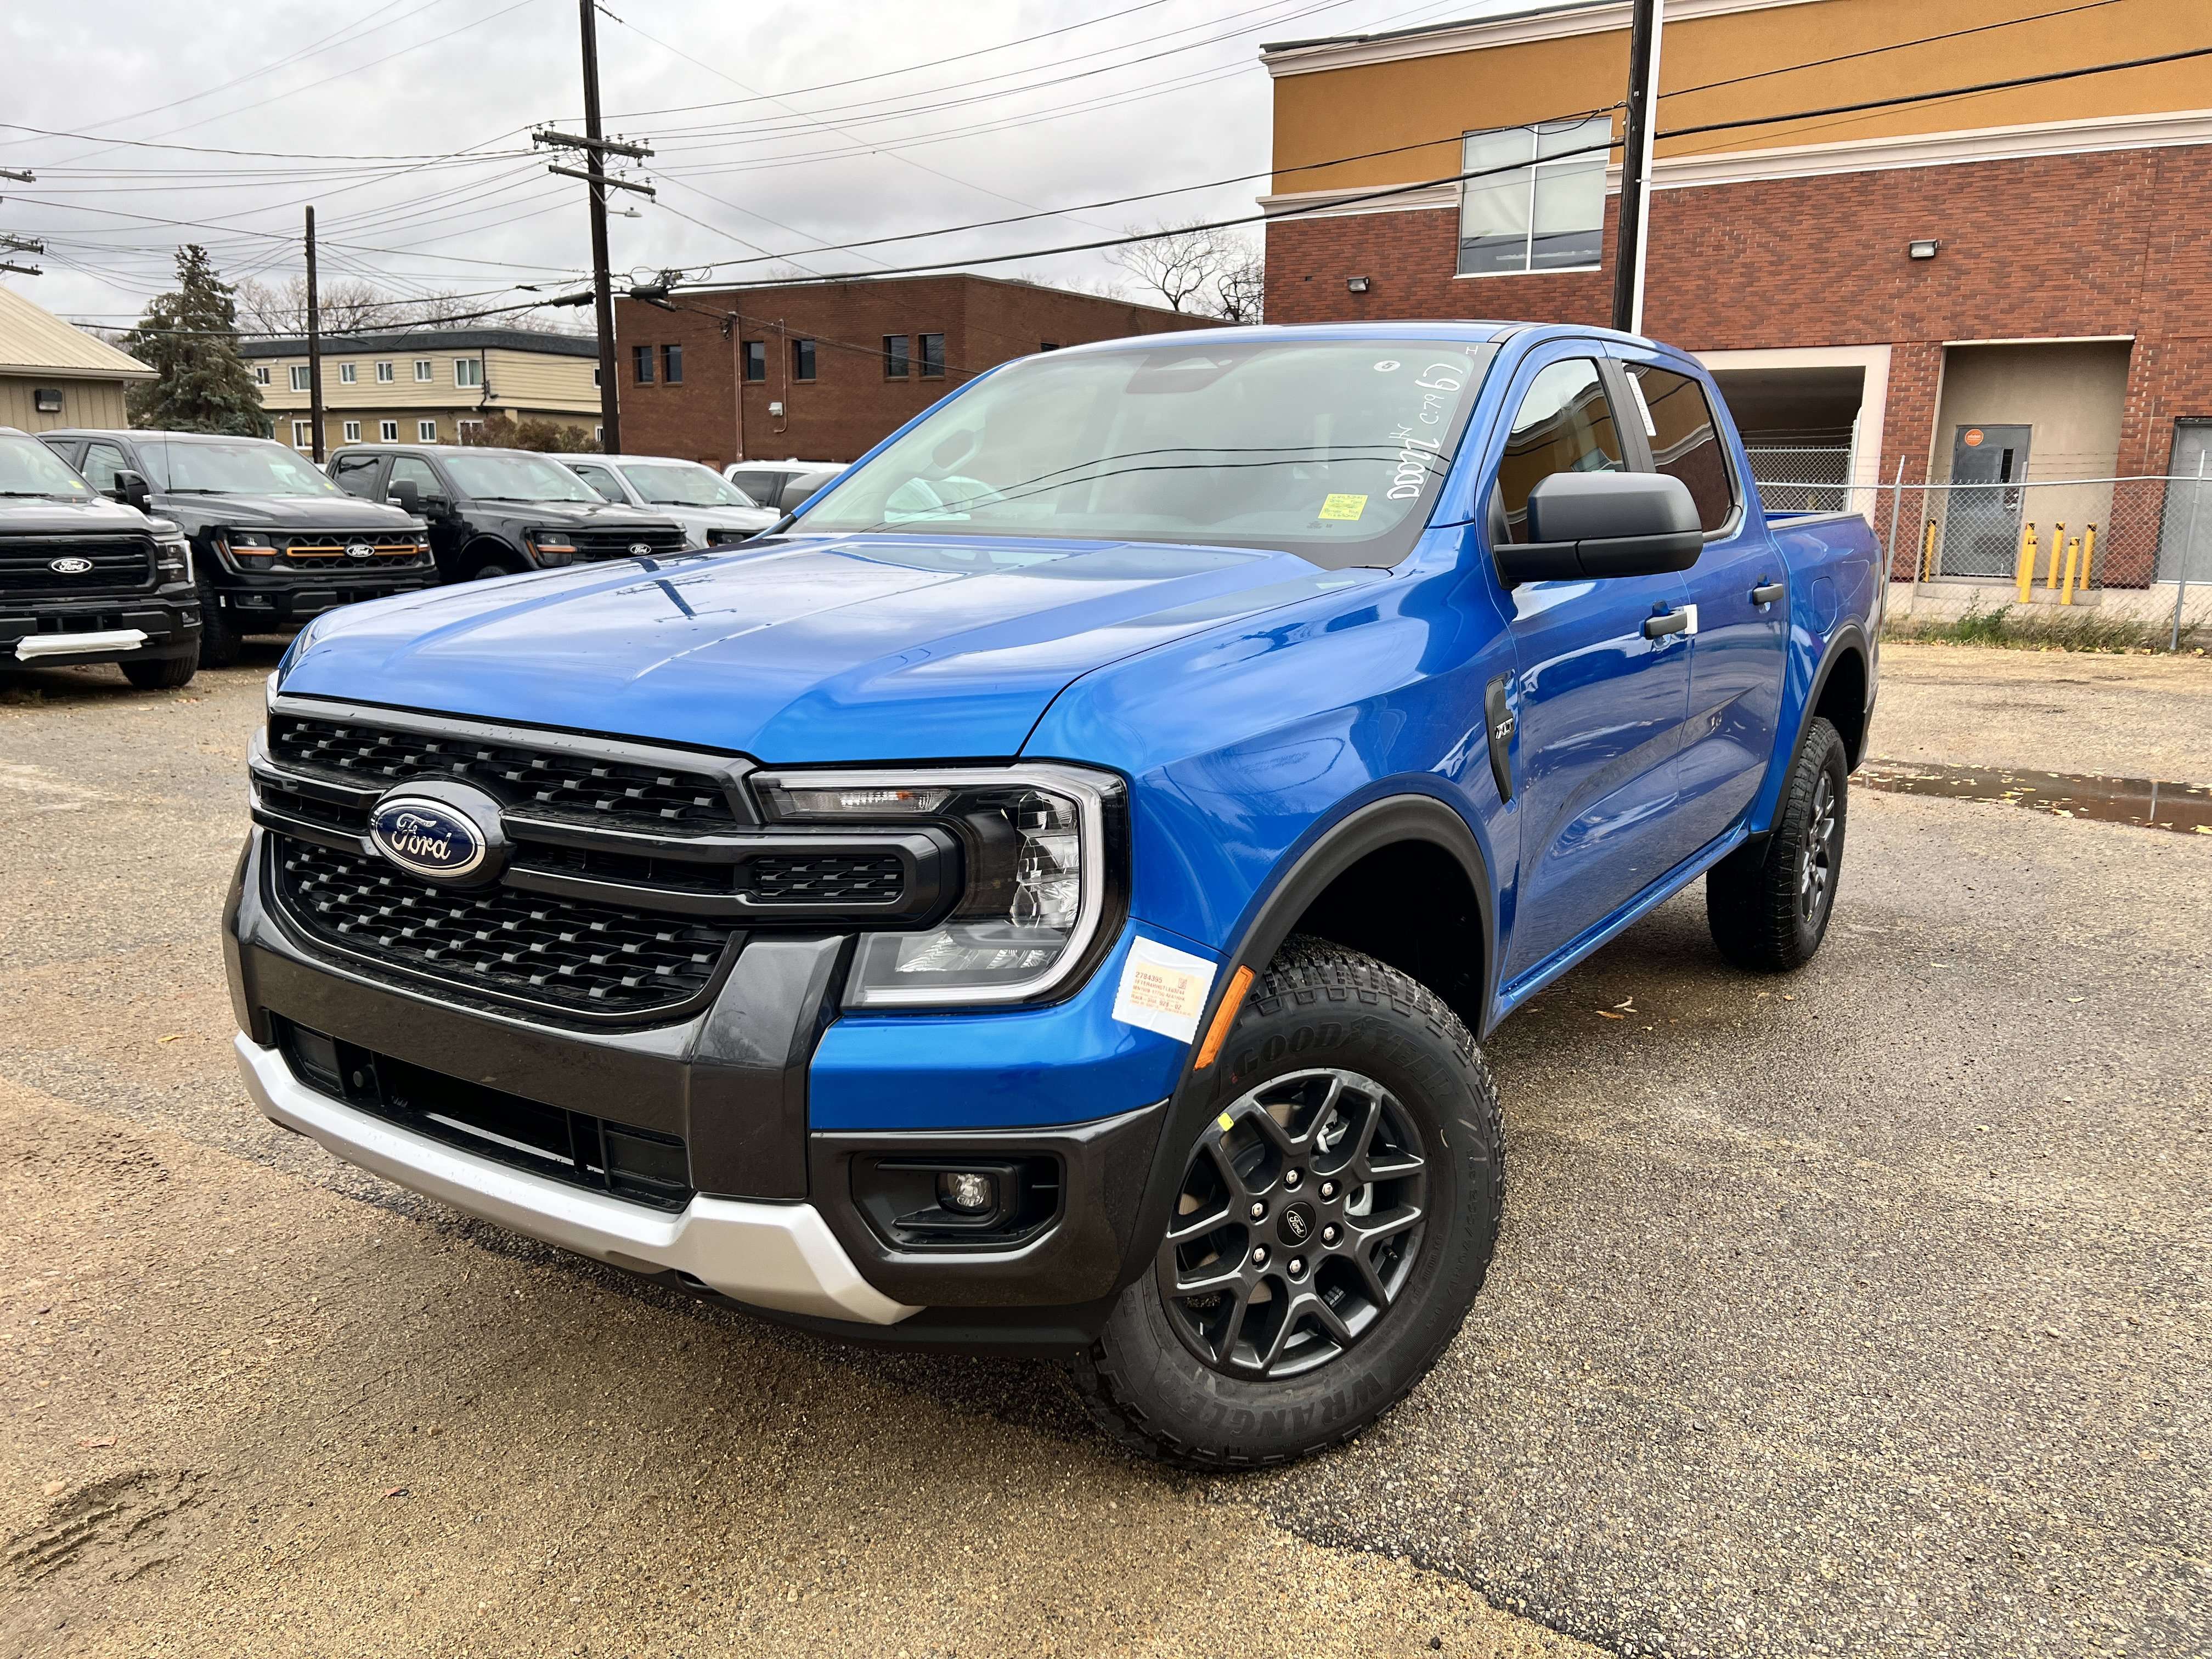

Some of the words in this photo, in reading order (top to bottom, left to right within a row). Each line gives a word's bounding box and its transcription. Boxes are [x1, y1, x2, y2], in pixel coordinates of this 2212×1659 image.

[59, 560, 84, 571] Ford
[1495, 718, 1514, 740] XLT
[391, 813, 453, 860] Ford
[1135, 972, 1163, 984] 2784395
[1233, 1016, 1457, 1102] GOODYEAR
[1160, 1370, 1385, 1438] WRANGLER
